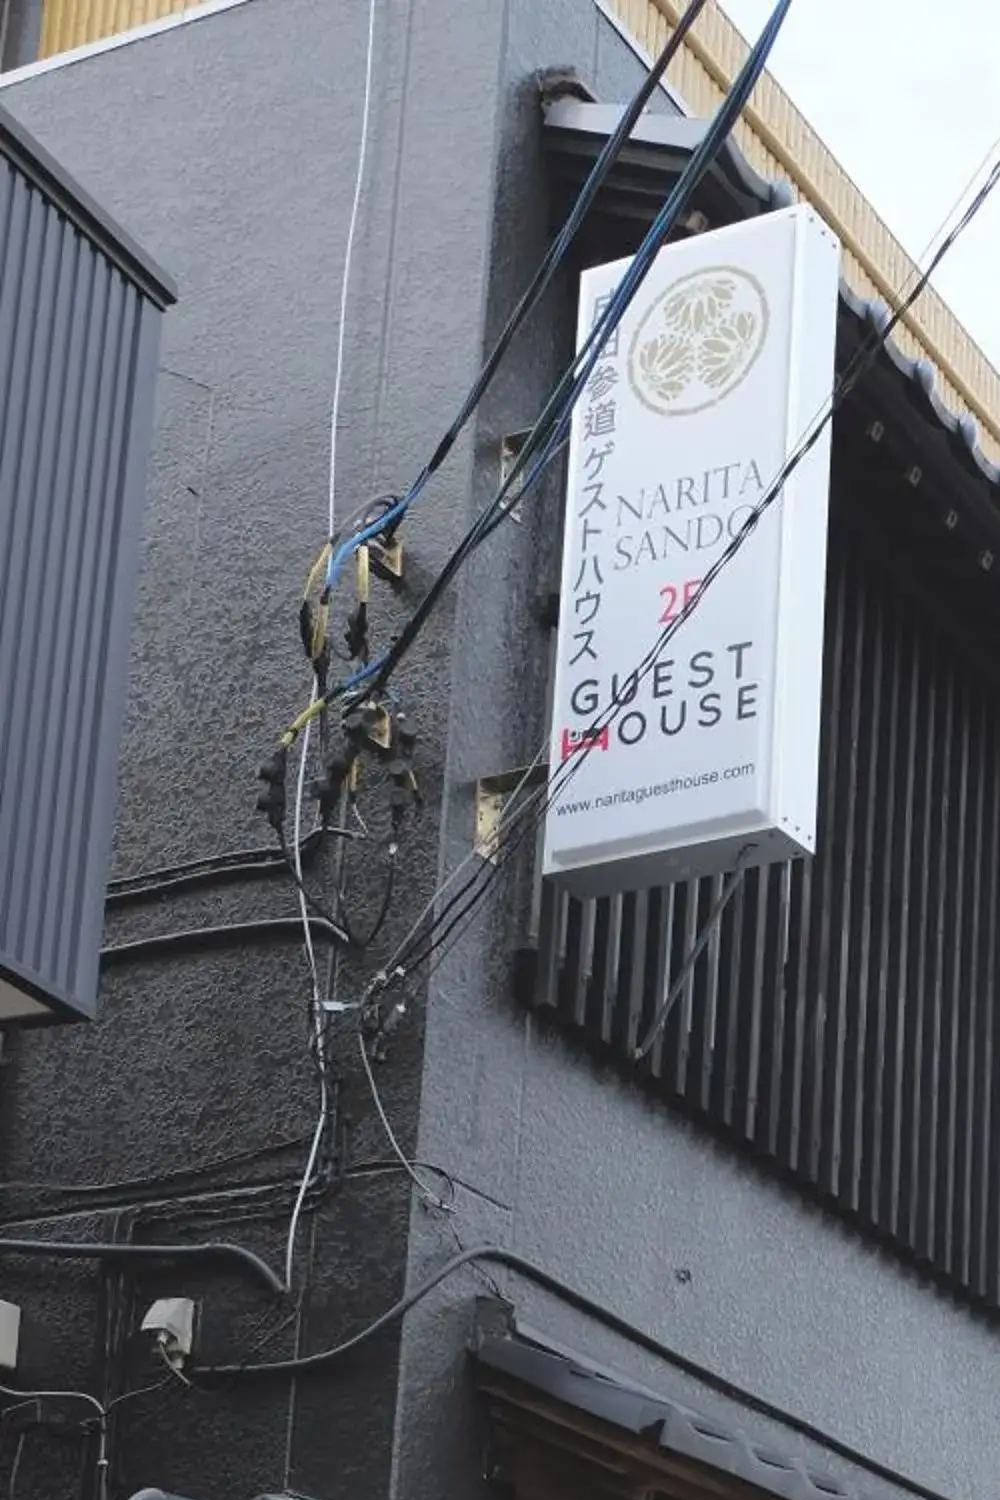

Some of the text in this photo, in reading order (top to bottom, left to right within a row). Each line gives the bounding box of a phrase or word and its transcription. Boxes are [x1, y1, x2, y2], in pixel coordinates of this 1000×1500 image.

[616, 458, 764, 527] NARITA
[613, 503, 759, 571] SANDO
[571, 641, 753, 715] GUEST
